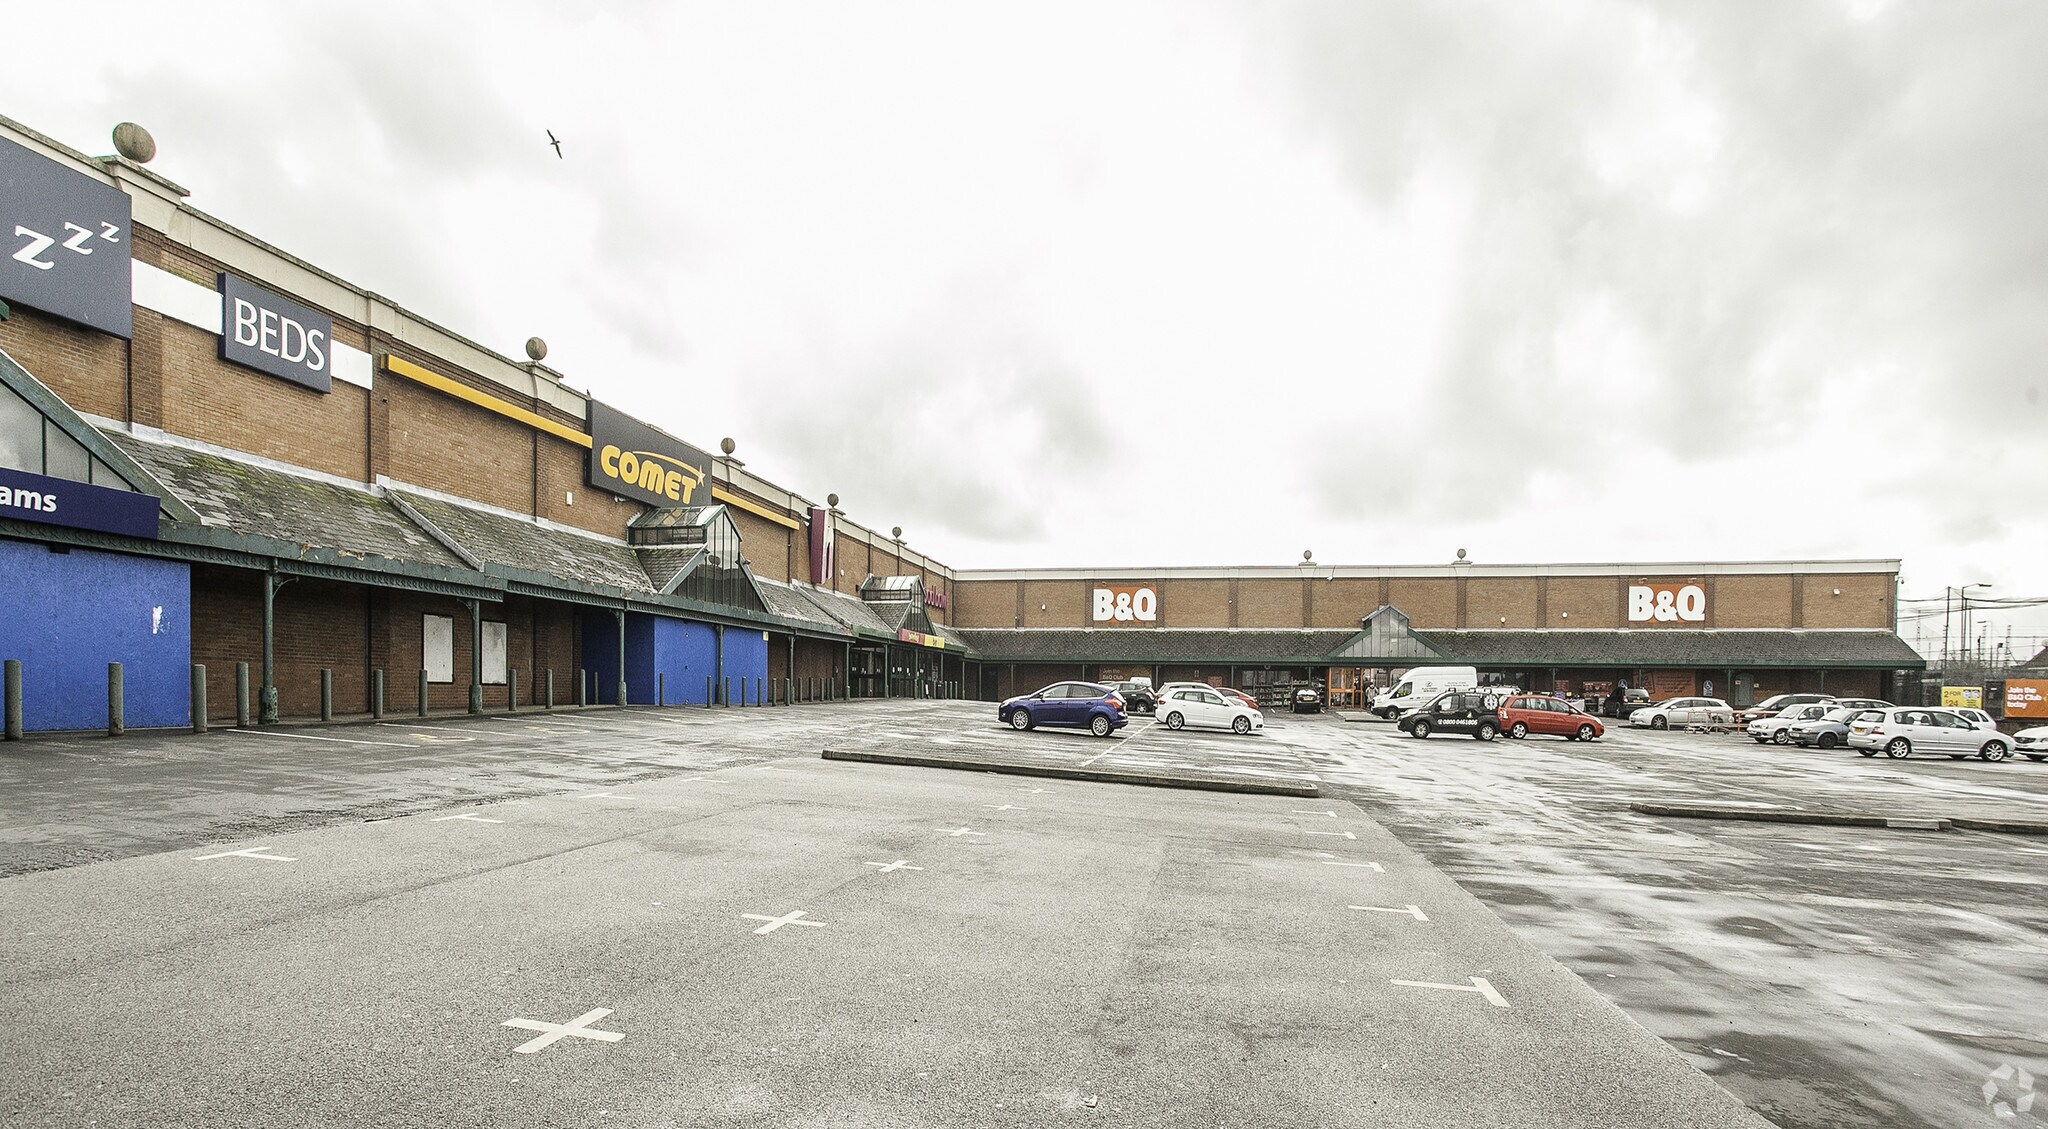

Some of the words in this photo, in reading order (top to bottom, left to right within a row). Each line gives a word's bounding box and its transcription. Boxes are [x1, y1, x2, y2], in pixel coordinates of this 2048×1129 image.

[234, 297, 325, 371] BEDS
[601, 445, 696, 505] COMET
[1093, 588, 1156, 621] B&Q
[1628, 585, 1705, 621] B&Q
[2007, 701, 2028, 709] today
